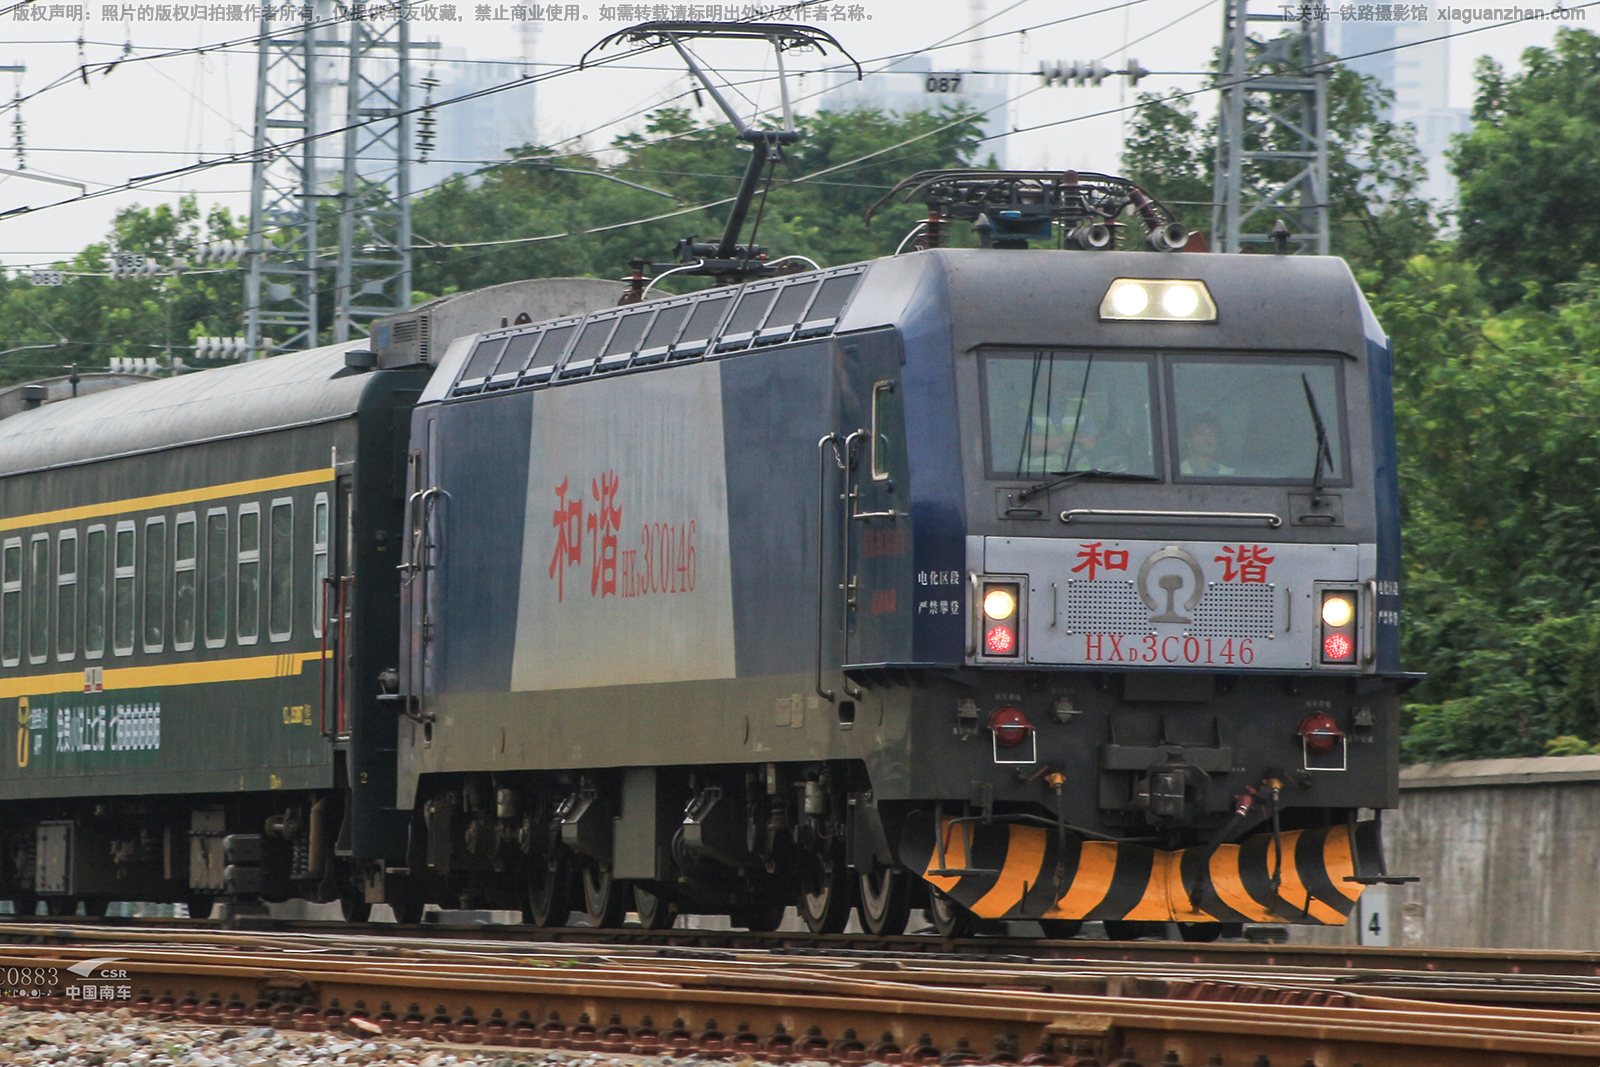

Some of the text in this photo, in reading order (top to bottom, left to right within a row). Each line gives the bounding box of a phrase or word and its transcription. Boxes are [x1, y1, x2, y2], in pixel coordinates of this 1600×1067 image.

[926, 77, 961, 92] 087
[548, 468, 623, 603] 和谐
[918, 570, 960, 586] 电化区段
[1084, 634, 1255, 665] HXD3C0146
[360, 771, 369, 784] 2
[1368, 912, 1382, 936] 4
